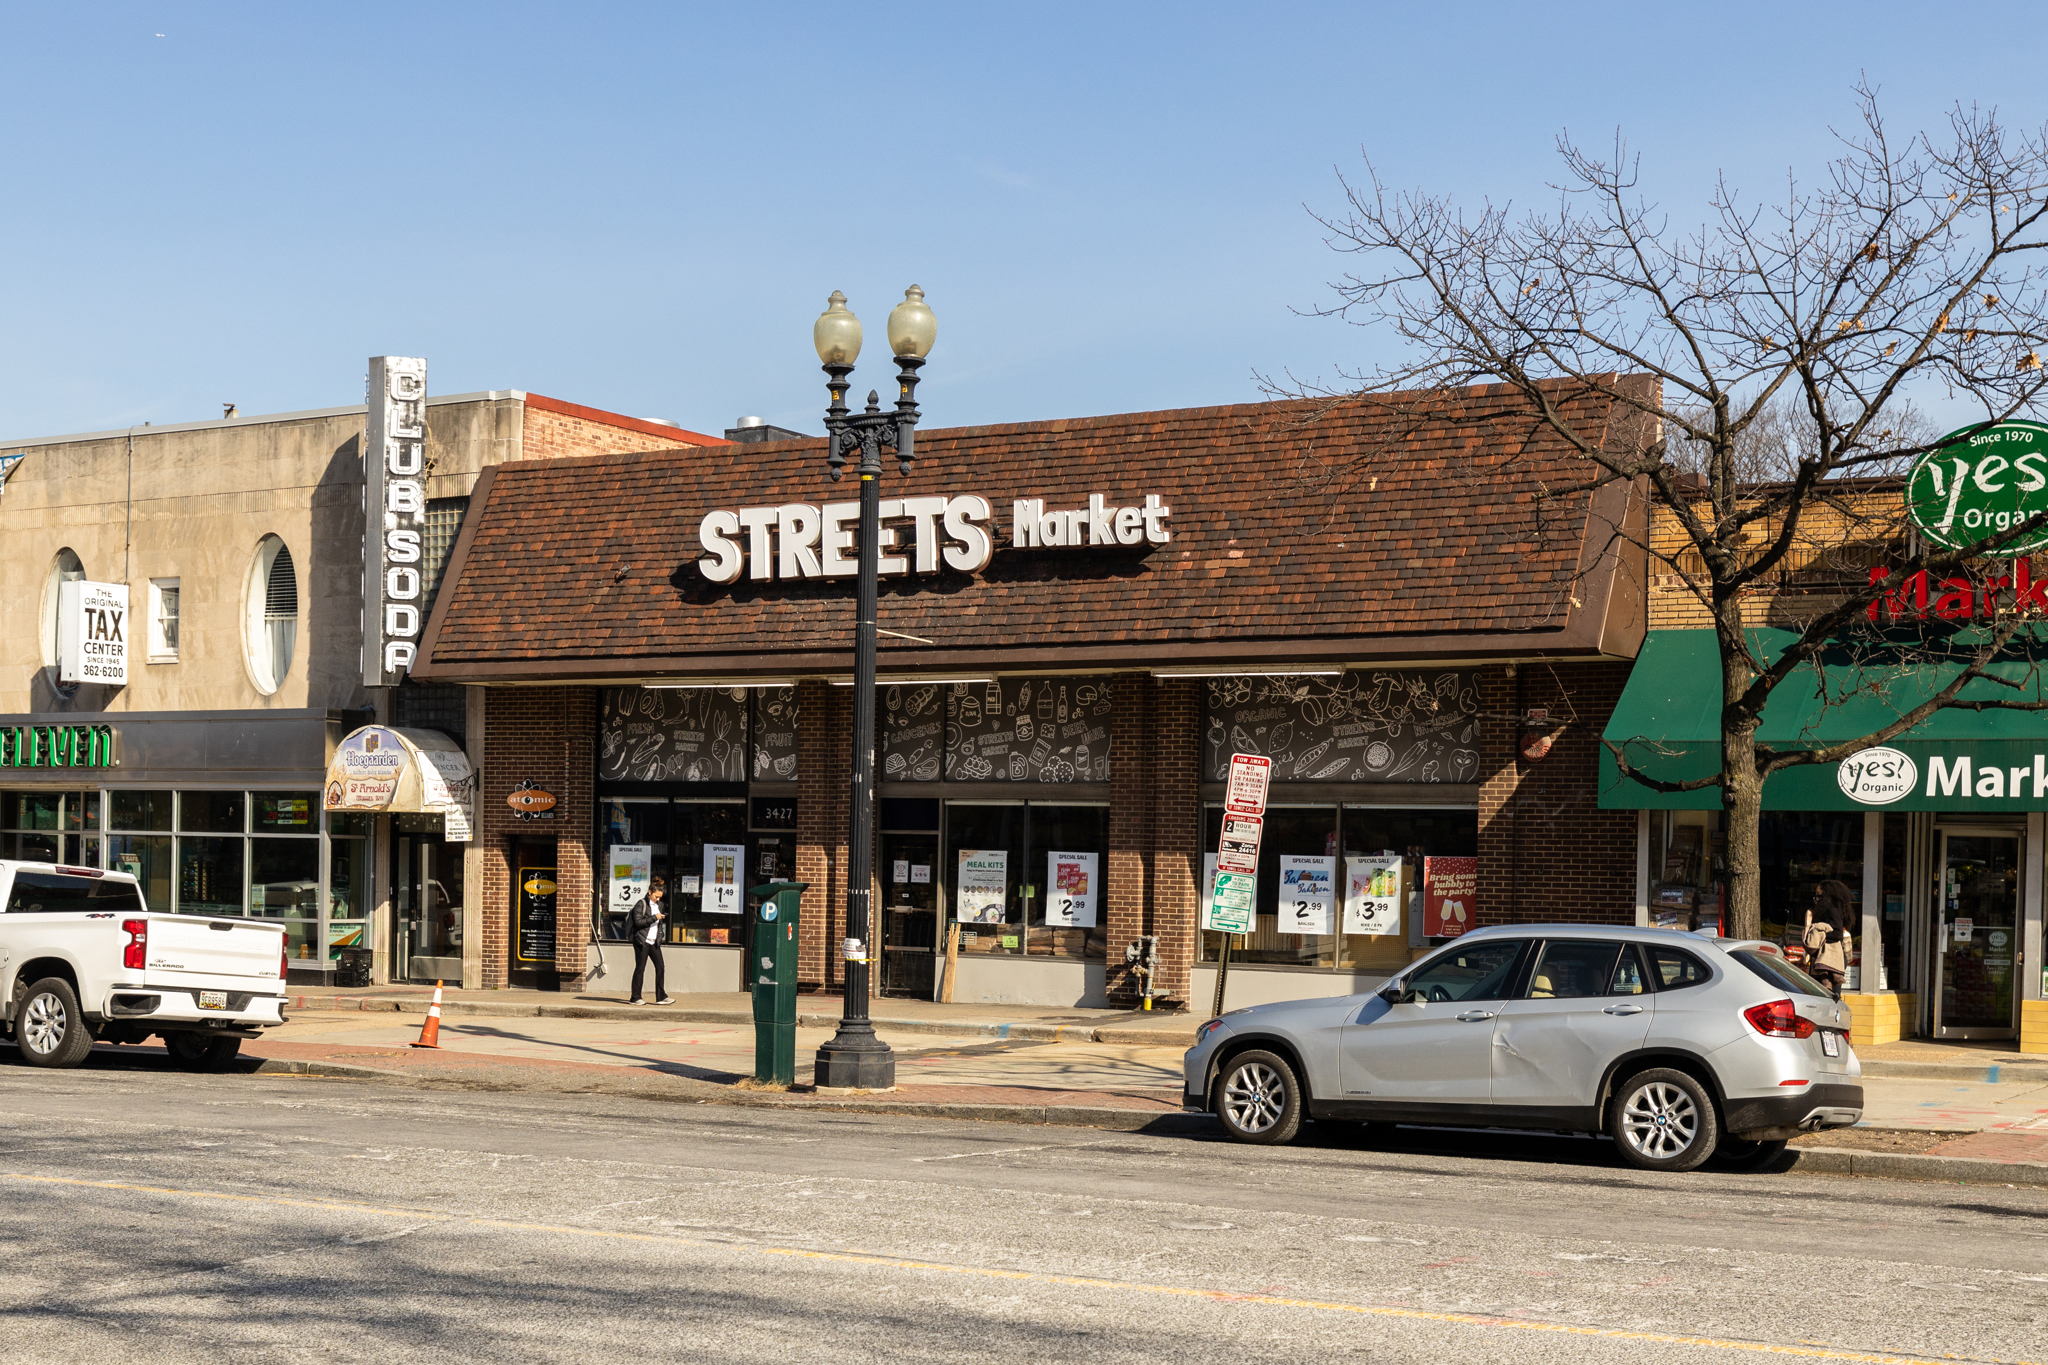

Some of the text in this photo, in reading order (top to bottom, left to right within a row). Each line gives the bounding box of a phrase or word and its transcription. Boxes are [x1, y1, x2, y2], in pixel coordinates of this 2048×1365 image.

[388, 371, 423, 513] CLUB
[1969, 431, 2034, 447] Since 1970
[698, 493, 1171, 585] STREETS Market
[96, 589, 112, 598] THE
[84, 598, 123, 608] ORIGINAL
[384, 530, 421, 674] SODA
[84, 608, 123, 642] TAX
[84, 642, 124, 656] CENTER
[1235, 707, 1288, 724] ORGANIC
[891, 721, 942, 744] GROCERIES
[1062, 720, 1088, 738] BEER
[764, 733, 794, 748] FRUIT
[977, 731, 1014, 745] STREETS
[346, 750, 399, 768] Hoegaarden
[1236, 770, 1264, 778] STANDING
[1242, 776, 1264, 784] PARKING
[1848, 758, 1905, 793] yes!
[1925, 754, 2048, 797] Mark
[1862, 783, 1904, 794] Organic
[510, 795, 555, 805] atomic
[766, 808, 792, 820] 3427
[1226, 822, 1232, 831] 2
[1430, 874, 1455, 882] Bring
[1434, 880, 1465, 889] bubbly
[619, 885, 642, 901] $3.99
[1434, 887, 1476, 897] the party!
[765, 902, 776, 920] P
[1058, 898, 1085, 916] $2.99
[1292, 900, 1322, 918] $2.99
[1356, 901, 1389, 920] $3.99
